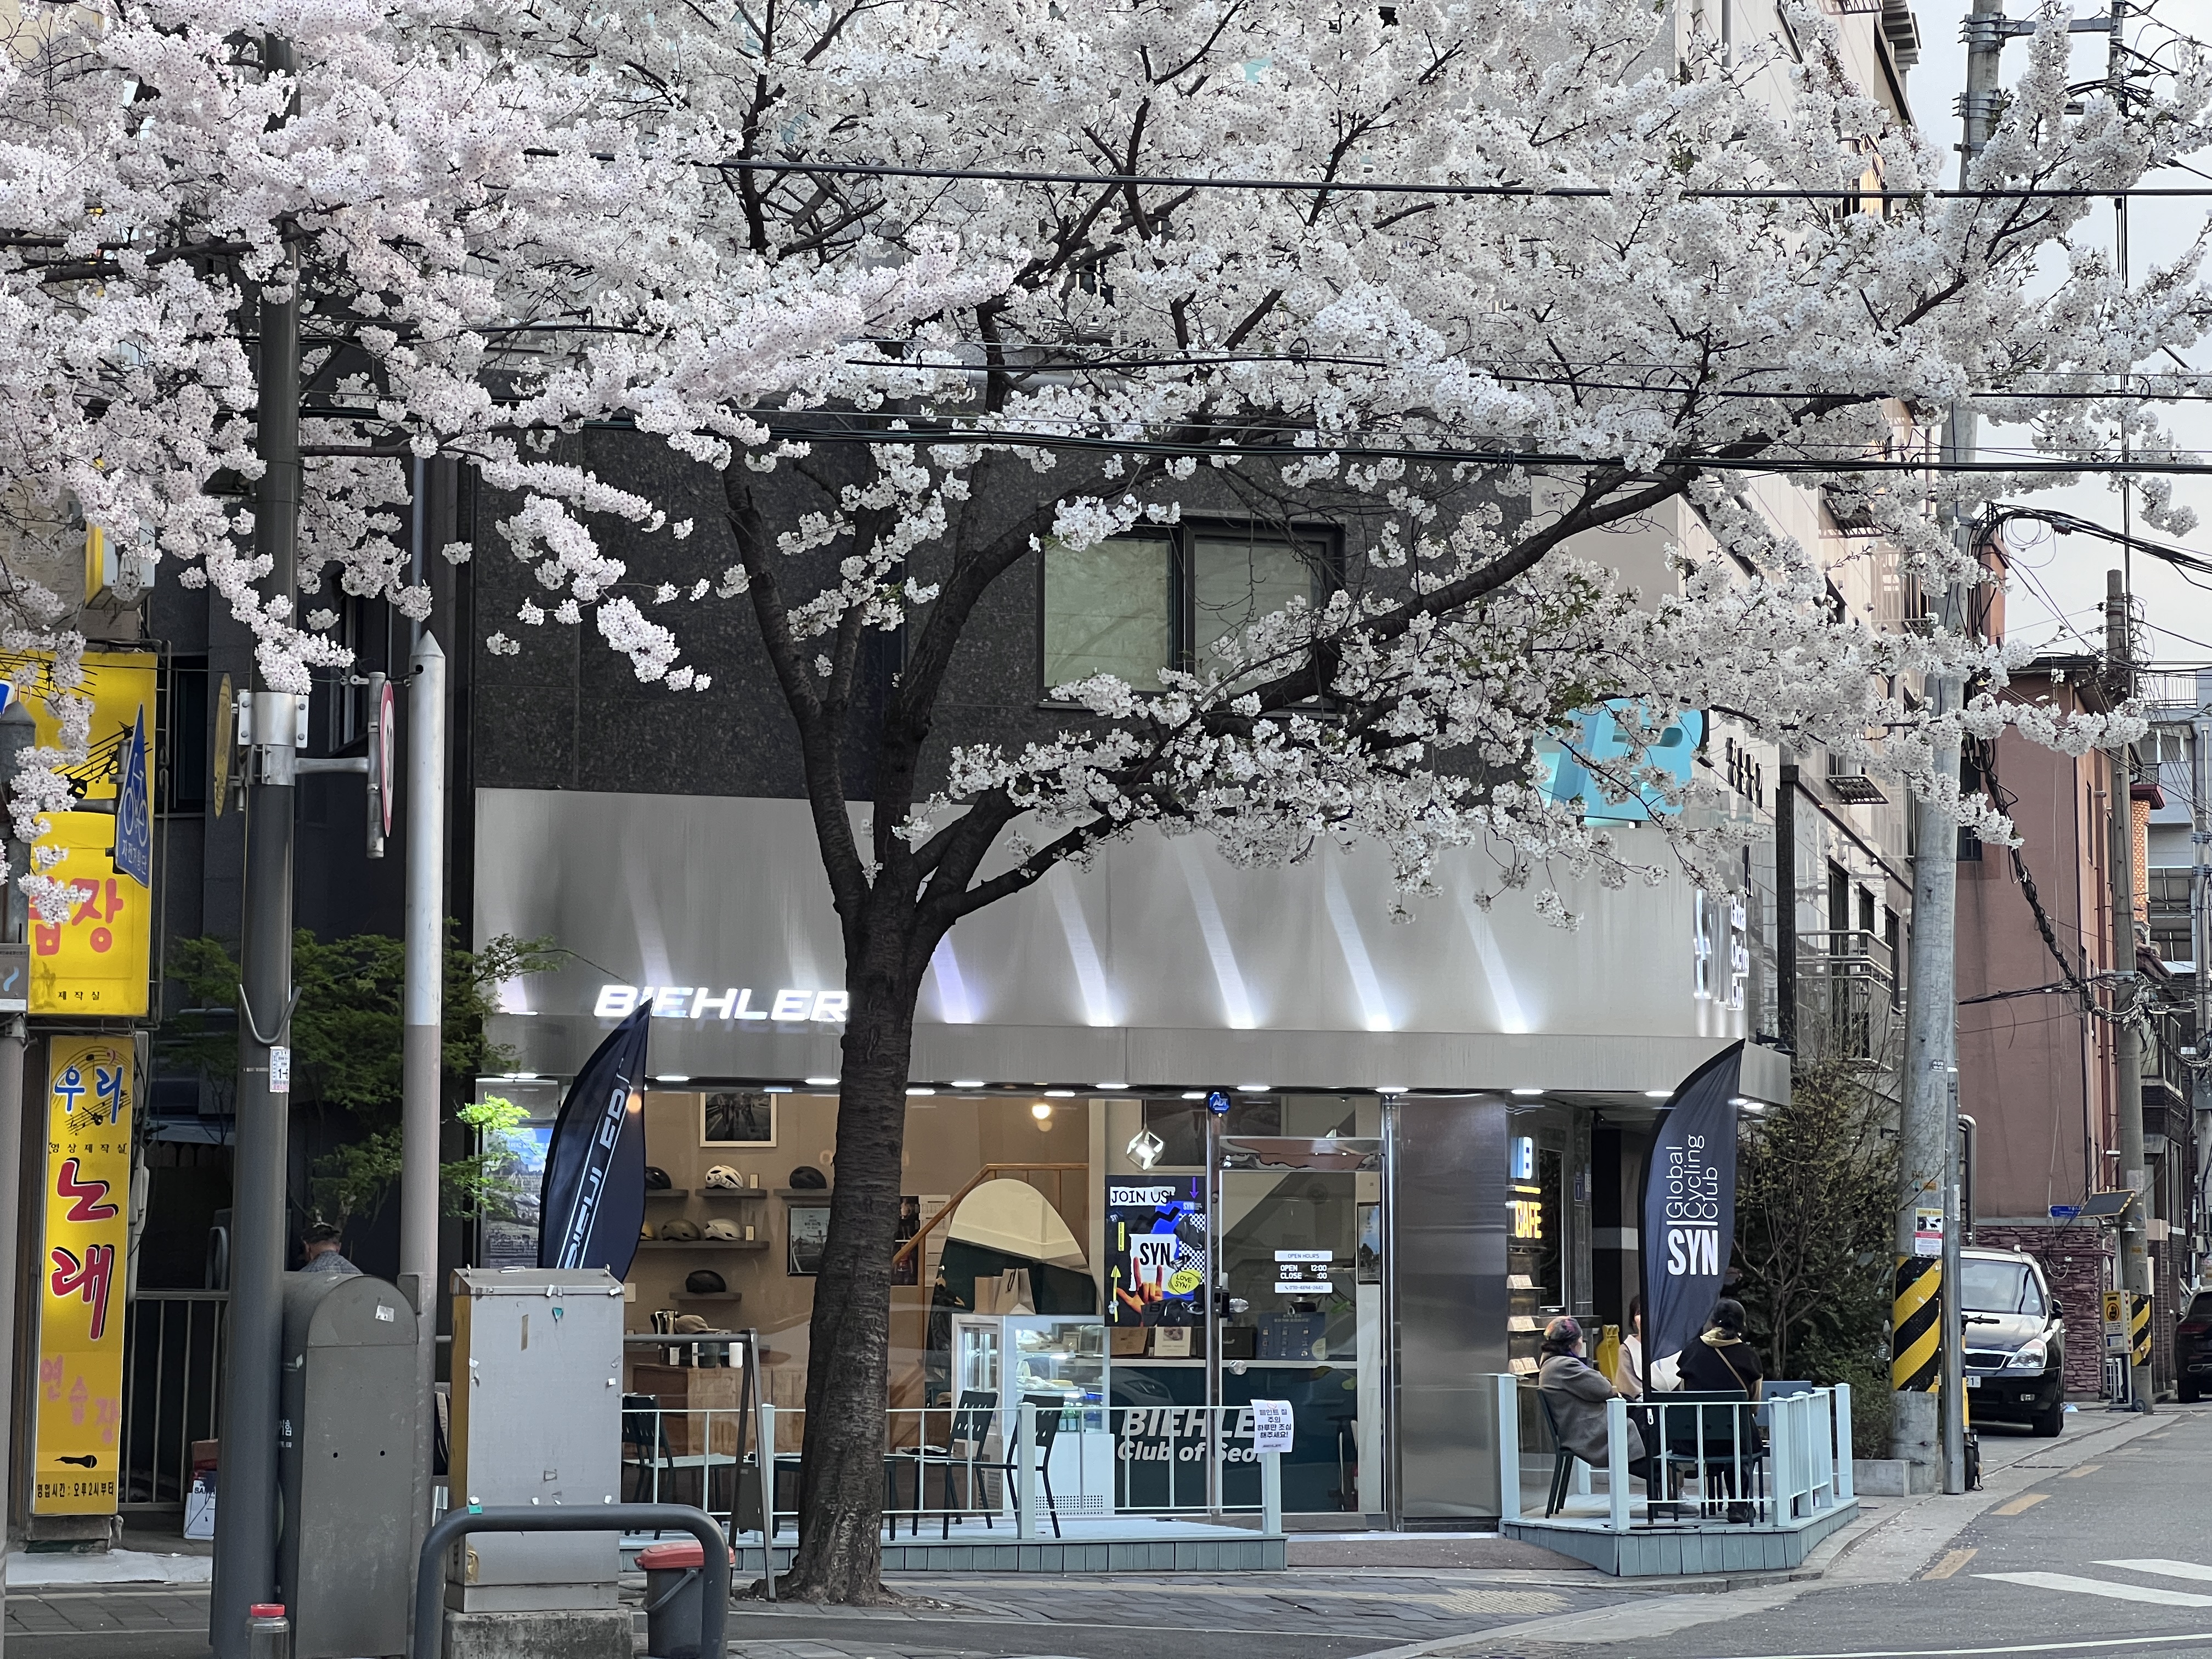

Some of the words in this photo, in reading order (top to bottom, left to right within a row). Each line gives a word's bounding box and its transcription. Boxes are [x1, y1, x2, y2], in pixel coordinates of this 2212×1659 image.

[594, 985, 849, 1022] BIEHLER
[55, 1065, 123, 1125] 우리
[1666, 1147, 1683, 1218] Global
[1684, 1135, 1705, 1218] Cycling
[1702, 1167, 1718, 1219] Club
[1111, 1190, 1146, 1203] JOIN
[1515, 1200, 1542, 1239] CAFE
[52, 1158, 119, 1340] 노래
[1139, 1243, 1170, 1266] SYN
[1667, 1228, 1718, 1276] SYN
[1176, 1274, 1192, 1283] LOVE
[1121, 1408, 1255, 1438] BIEHLE
[1118, 1441, 1171, 1460] Club
[1179, 1442, 1206, 1461] of
